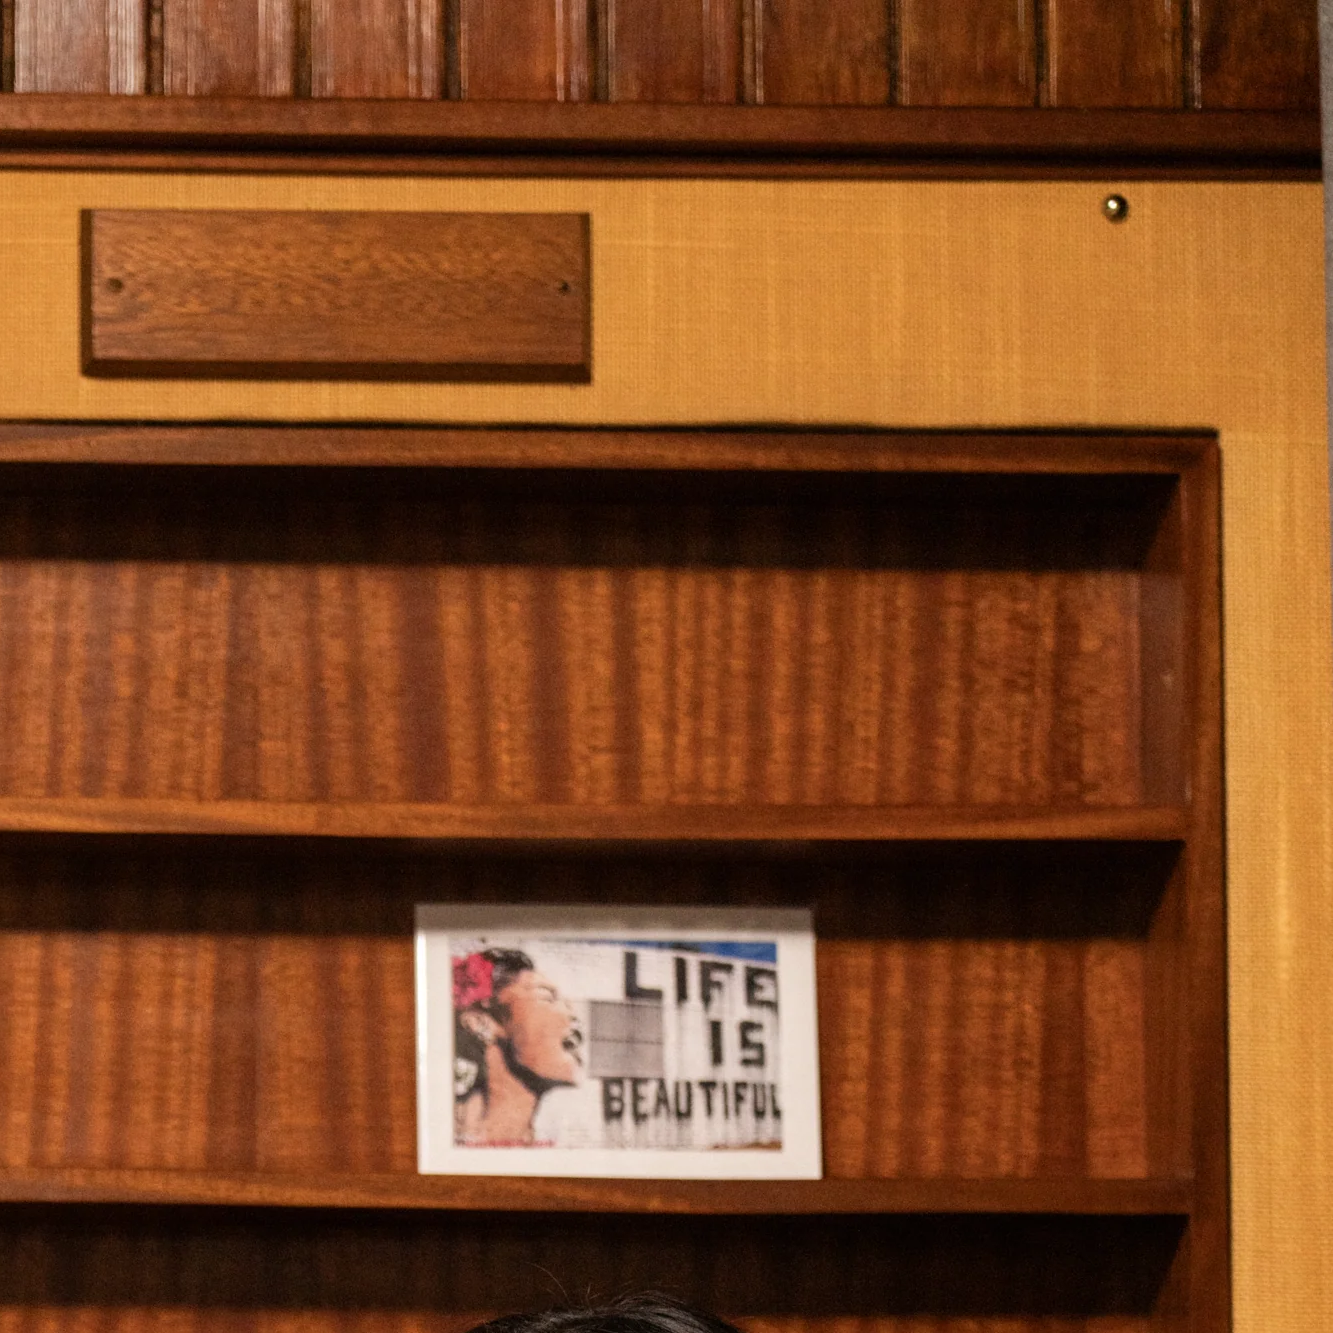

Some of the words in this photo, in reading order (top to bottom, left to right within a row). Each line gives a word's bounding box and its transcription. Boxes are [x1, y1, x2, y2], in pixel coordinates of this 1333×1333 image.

[624, 950, 779, 1011] LIFE
[709, 1019, 765, 1067] IS
[602, 1077, 781, 1122] BEAUTIFUL
